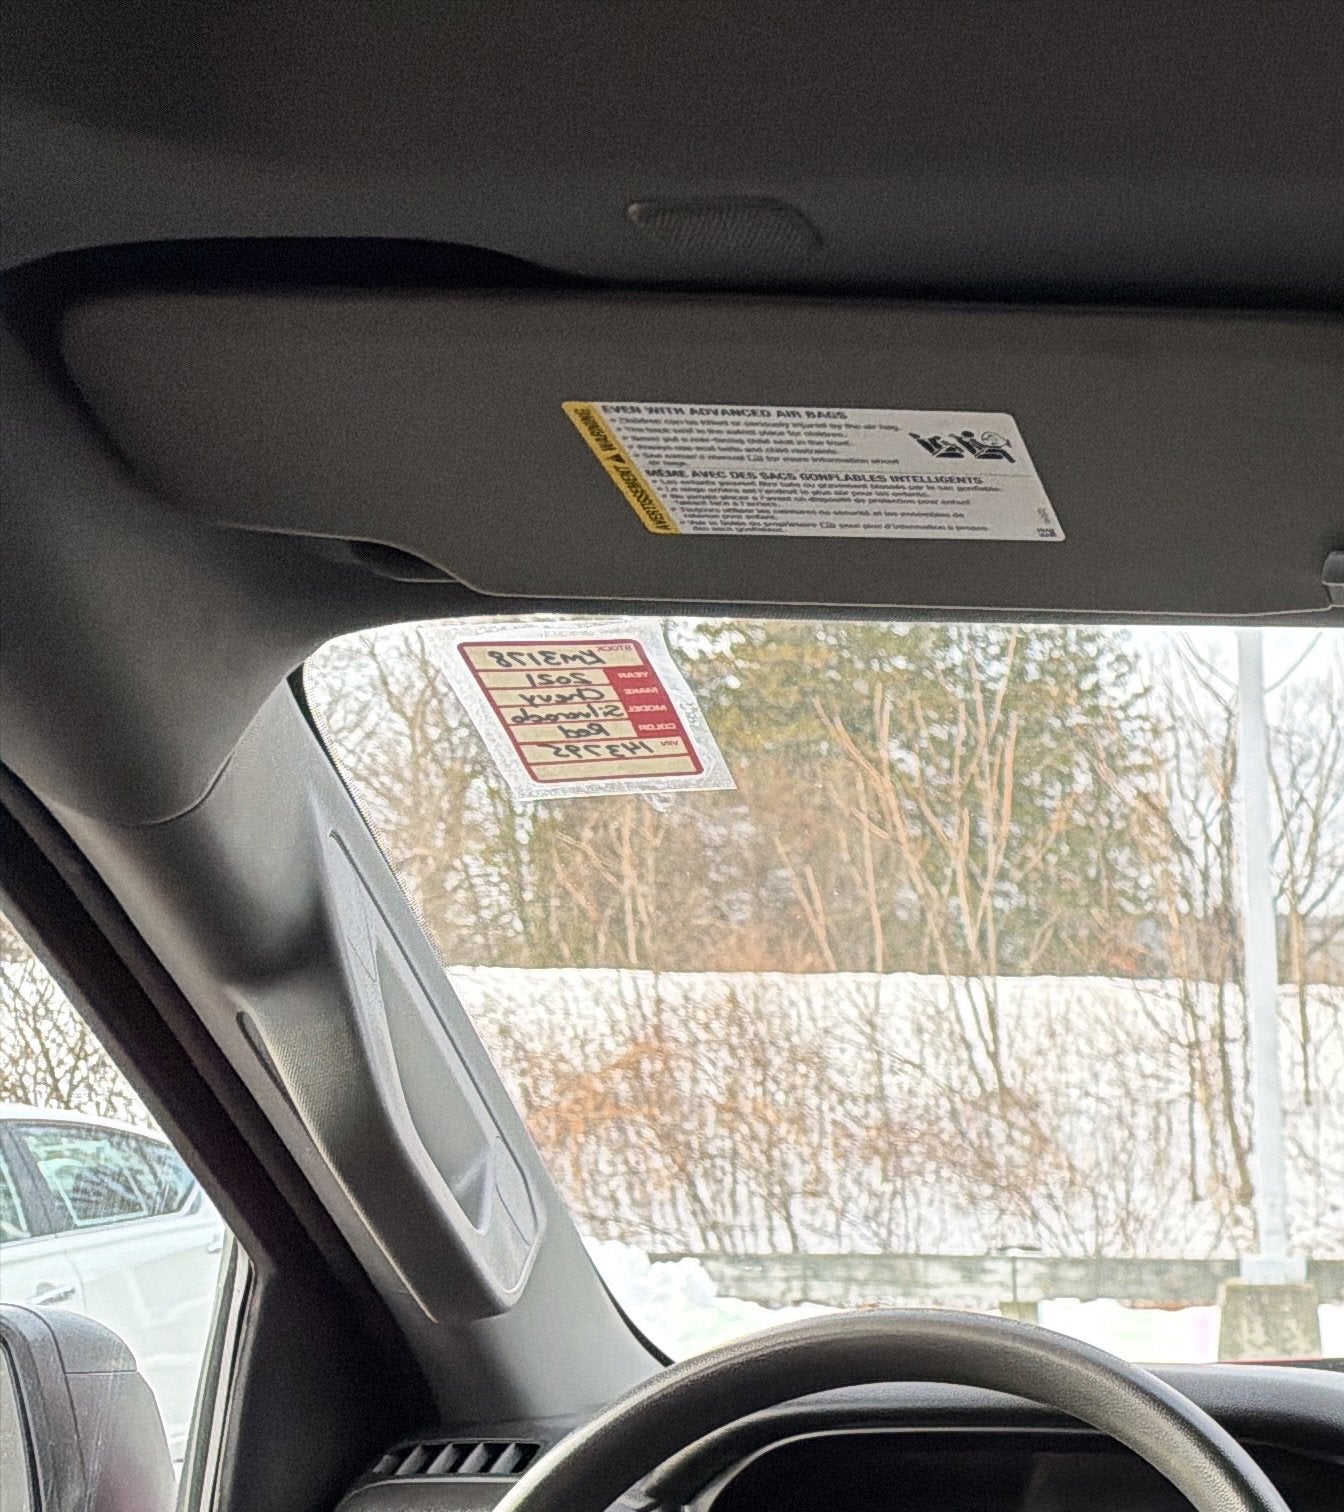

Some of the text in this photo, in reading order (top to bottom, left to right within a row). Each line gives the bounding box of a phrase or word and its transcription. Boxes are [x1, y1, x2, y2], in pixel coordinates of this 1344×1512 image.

[601, 405, 848, 420] EVEN WITH ADVANCED AIR BAGS
[692, 470, 727, 479] AVEC
[730, 471, 757, 480] DES
[759, 472, 798, 481] SACS
[890, 475, 984, 485] INTELLIGENTS
